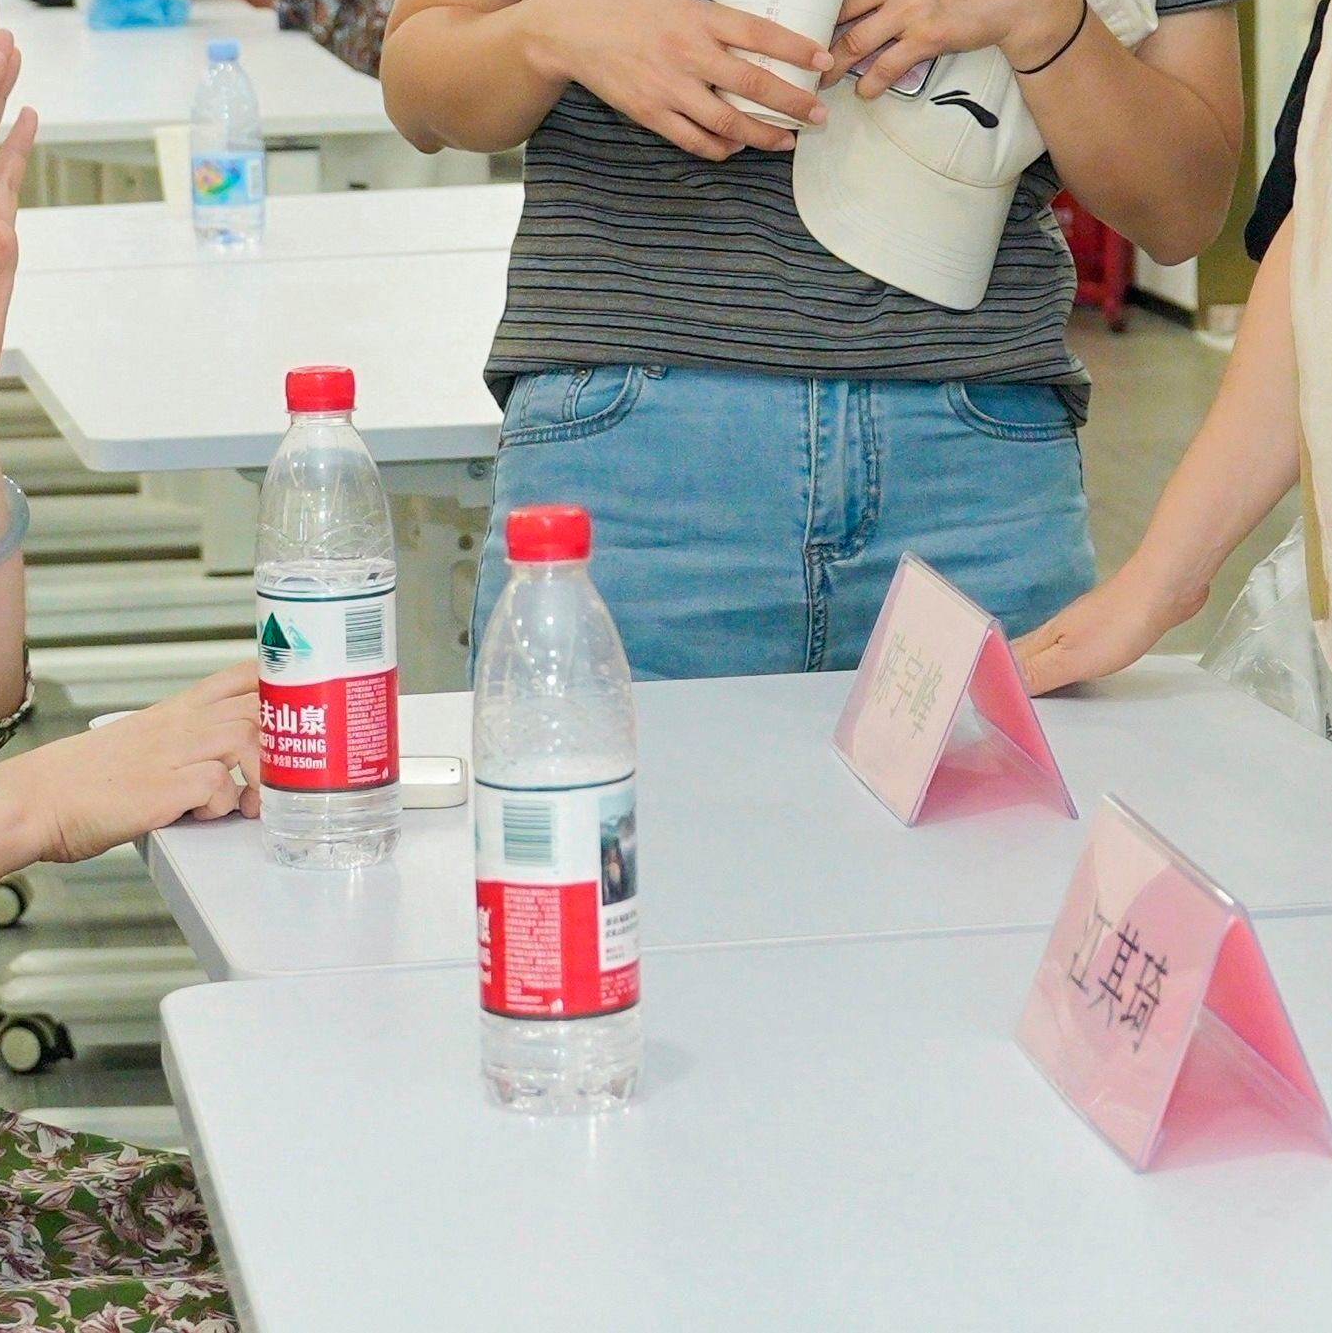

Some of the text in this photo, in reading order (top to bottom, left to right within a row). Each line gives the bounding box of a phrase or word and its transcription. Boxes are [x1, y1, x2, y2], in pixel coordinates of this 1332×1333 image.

[260, 699, 326, 735] 夫山泉
[278, 736, 326, 753] SPRING
